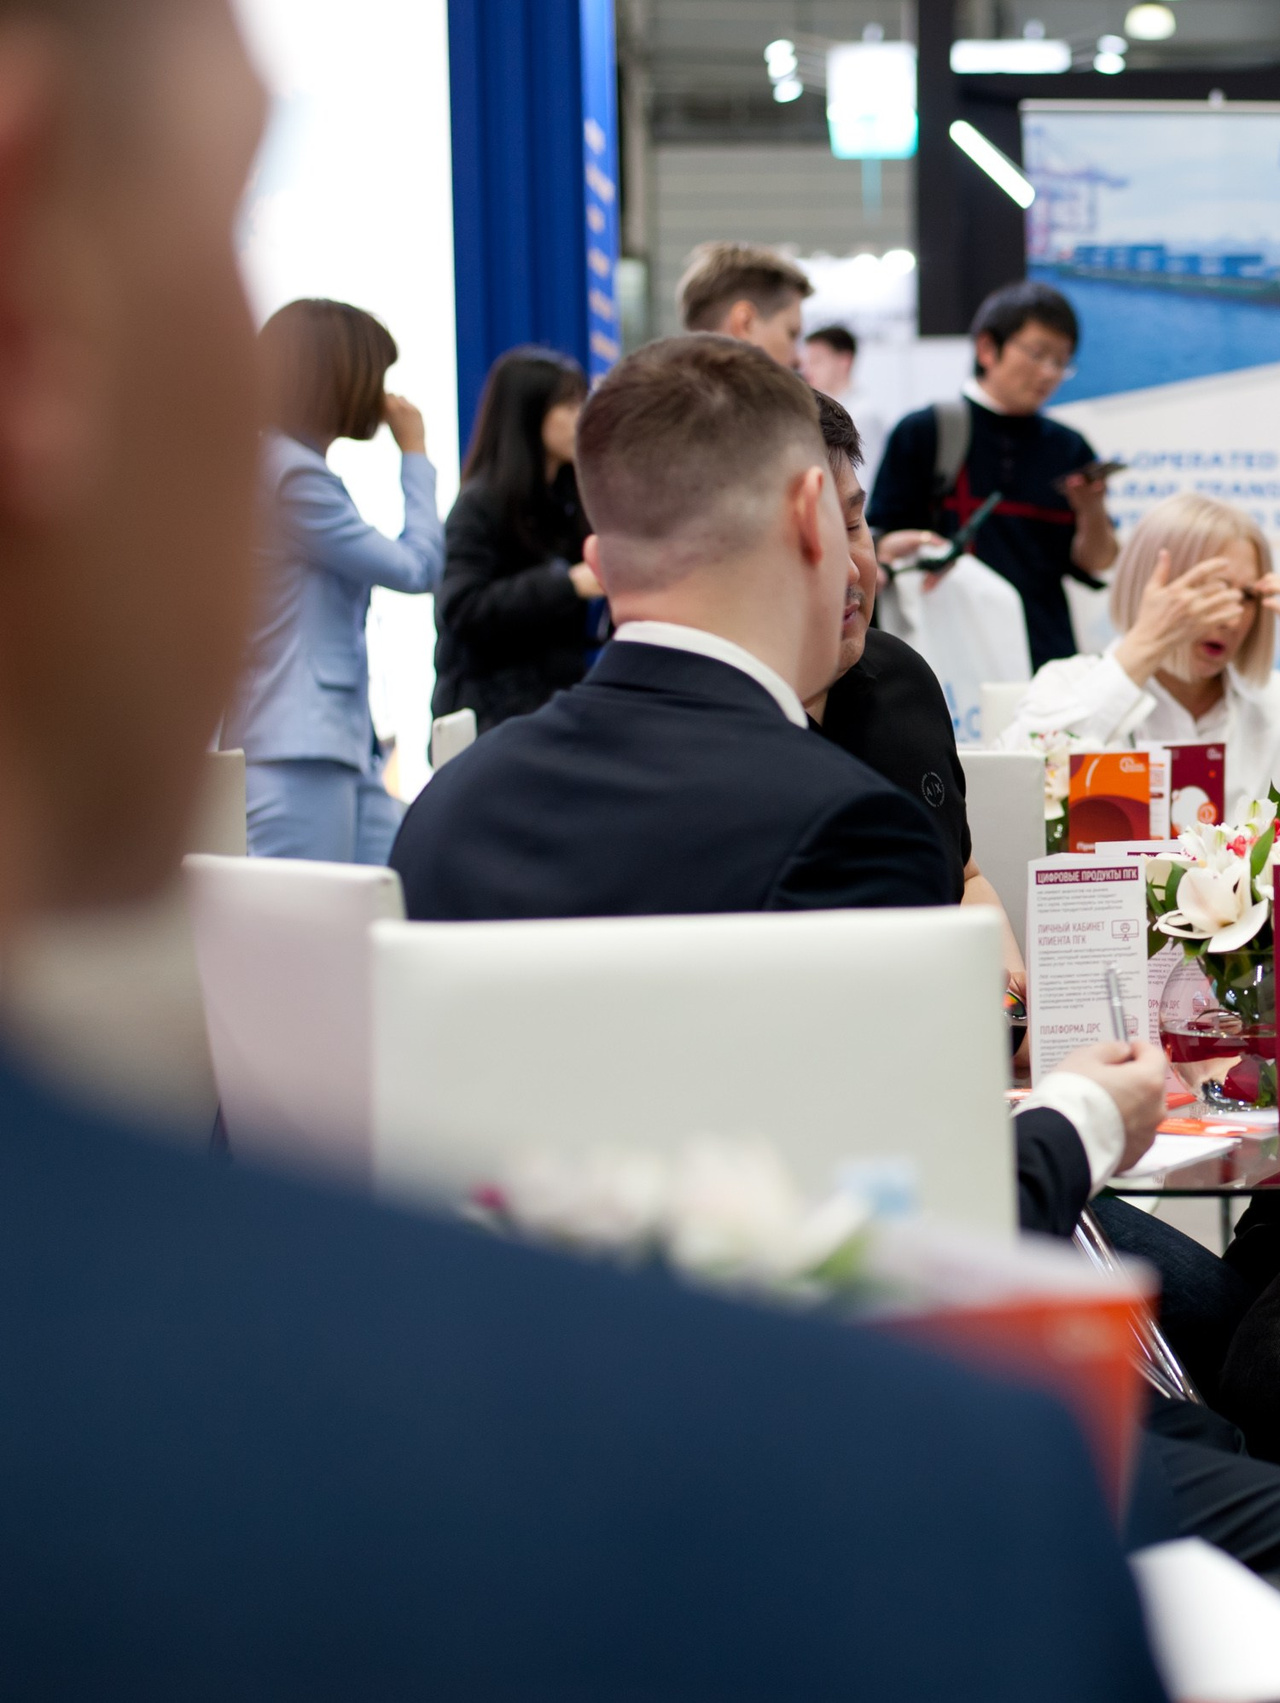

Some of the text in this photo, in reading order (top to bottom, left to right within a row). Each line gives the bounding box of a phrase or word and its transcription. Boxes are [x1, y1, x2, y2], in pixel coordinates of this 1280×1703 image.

[1037, 869, 1138, 884] ЦИФРОВЫЕ ПРОДУКТЫ ПГК
[1038, 921, 1105, 934] ЛИЧНЫЙ КАБИНЕТ
[1038, 935, 1087, 946] КЛИЕНТА ПГК
[1040, 1022, 1101, 1035] ПЛАТФОРМА ДРС
